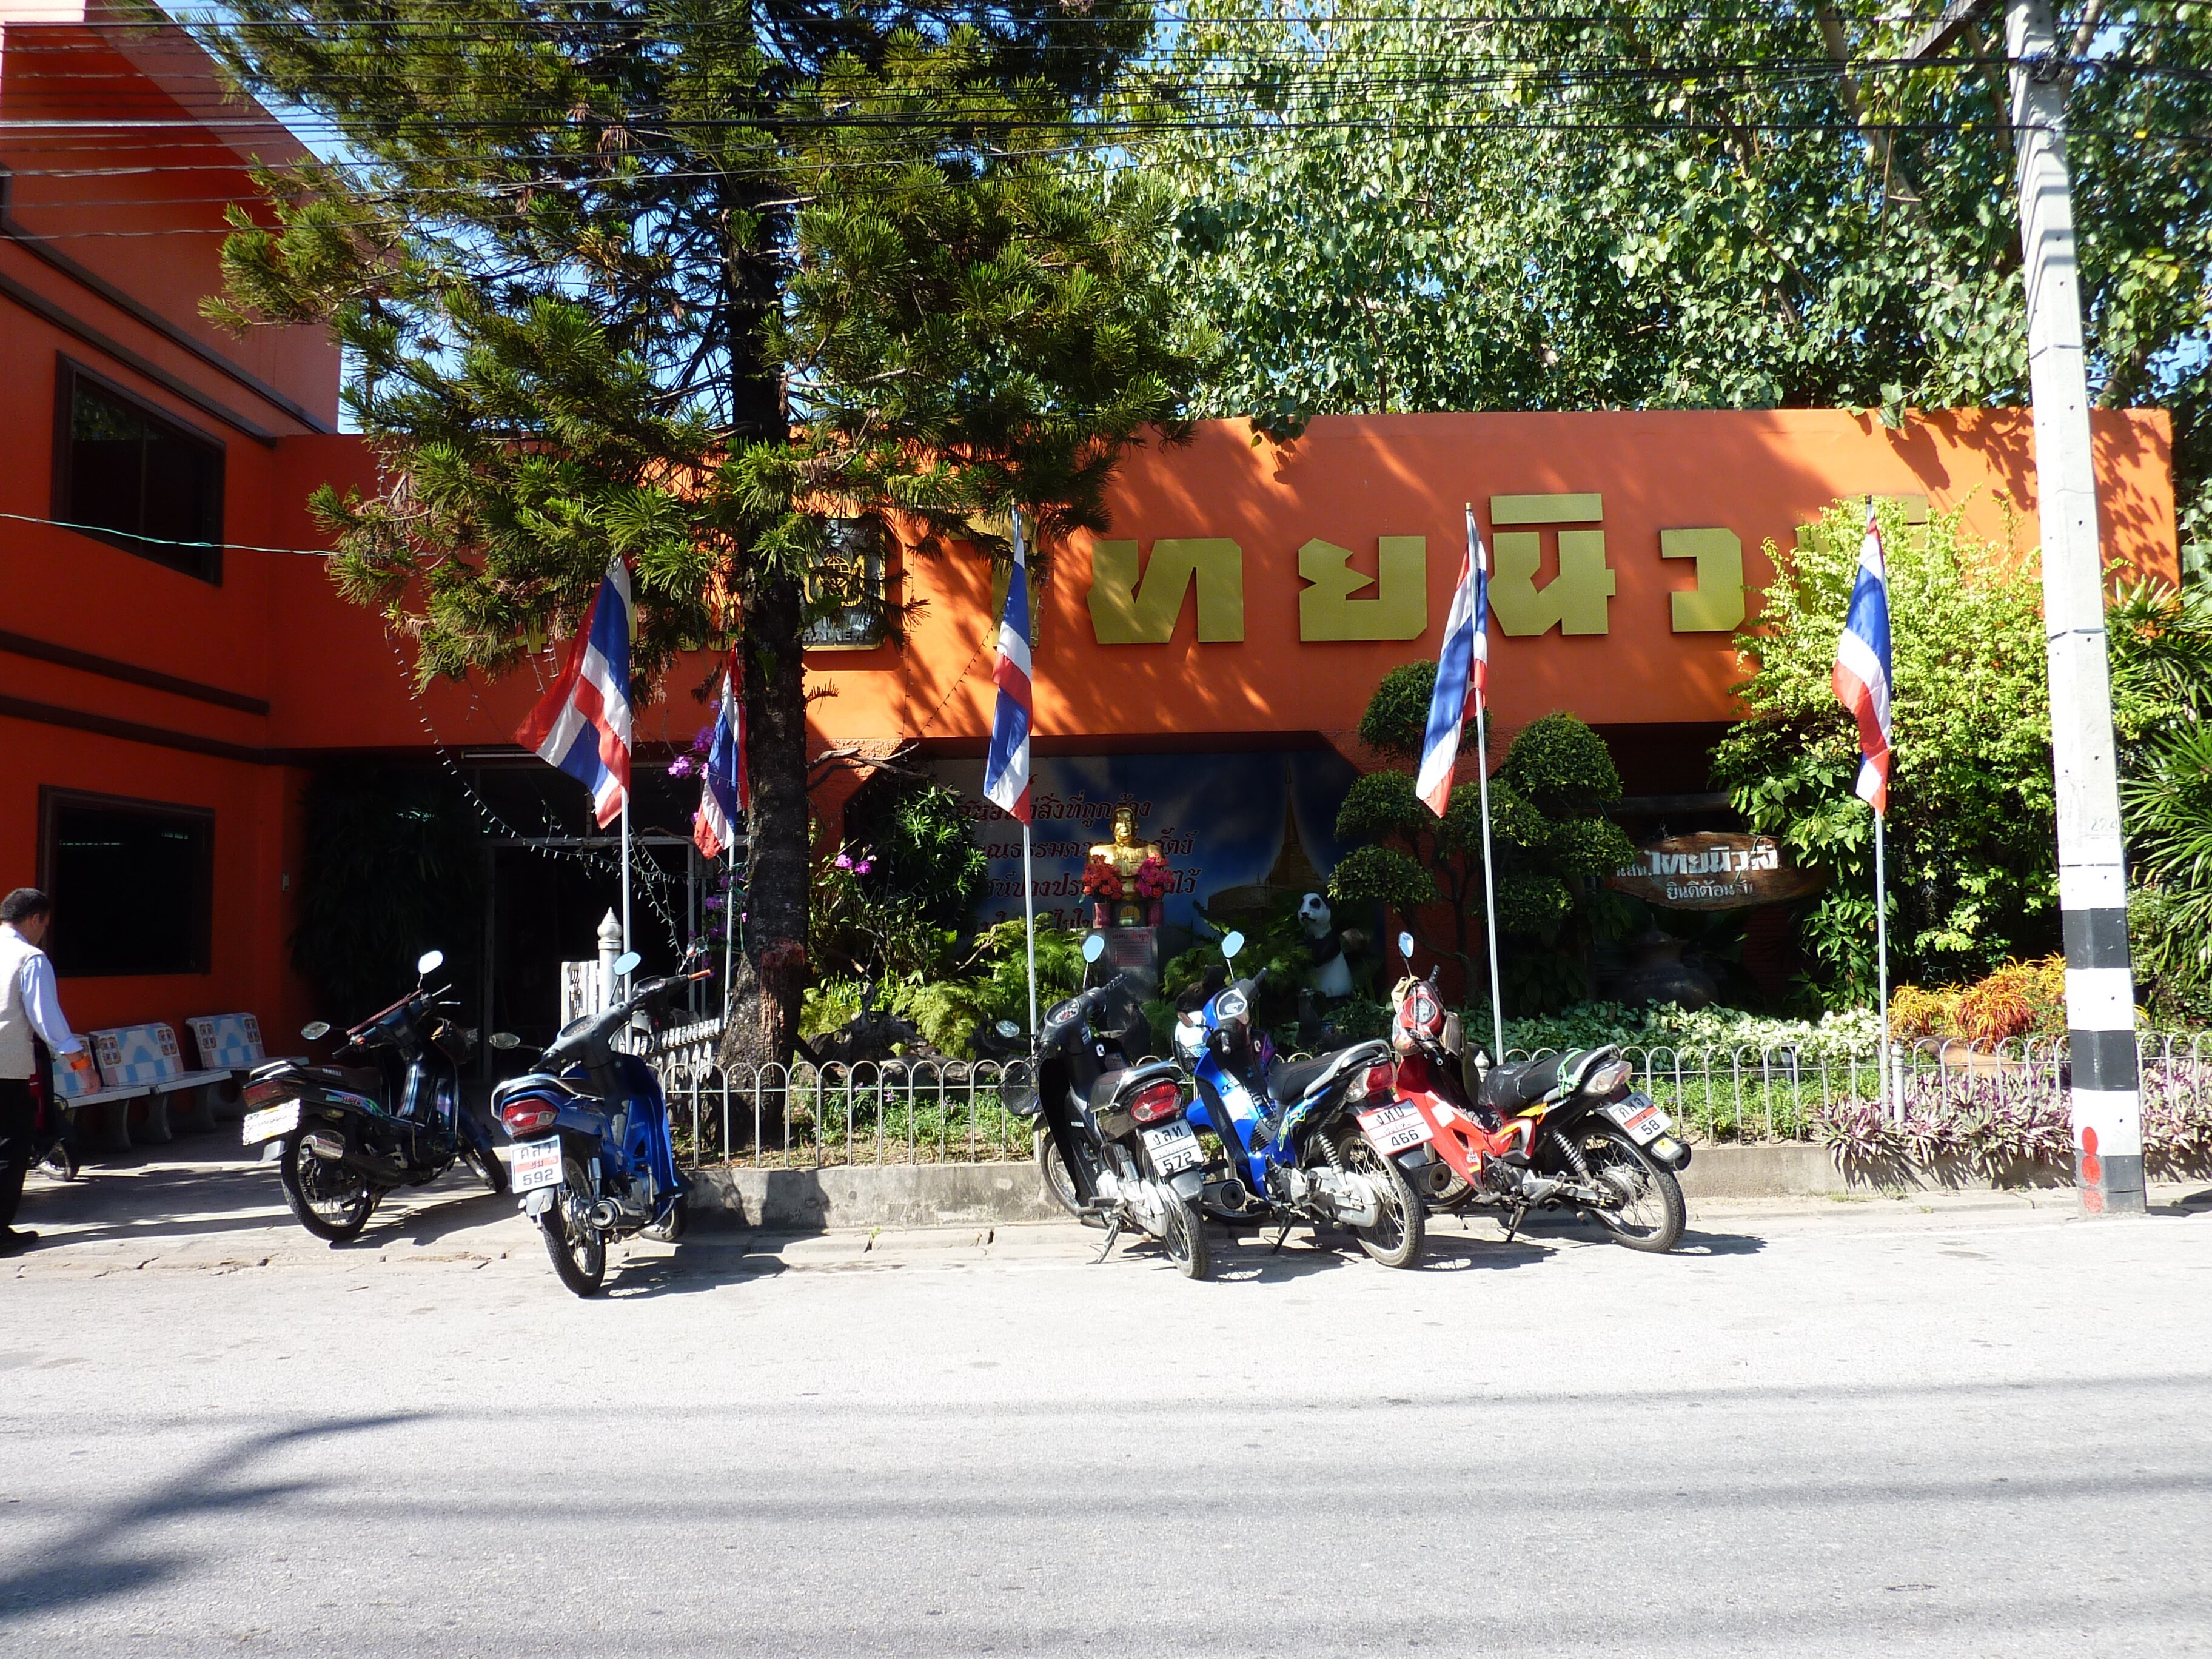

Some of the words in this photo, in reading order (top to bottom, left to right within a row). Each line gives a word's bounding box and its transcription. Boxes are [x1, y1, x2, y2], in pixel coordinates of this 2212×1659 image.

[1640, 1119, 1661, 1136] 58
[1391, 1128, 1420, 1147] 466
[1162, 1151, 1195, 1172] 572
[522, 1168, 554, 1187] 592
